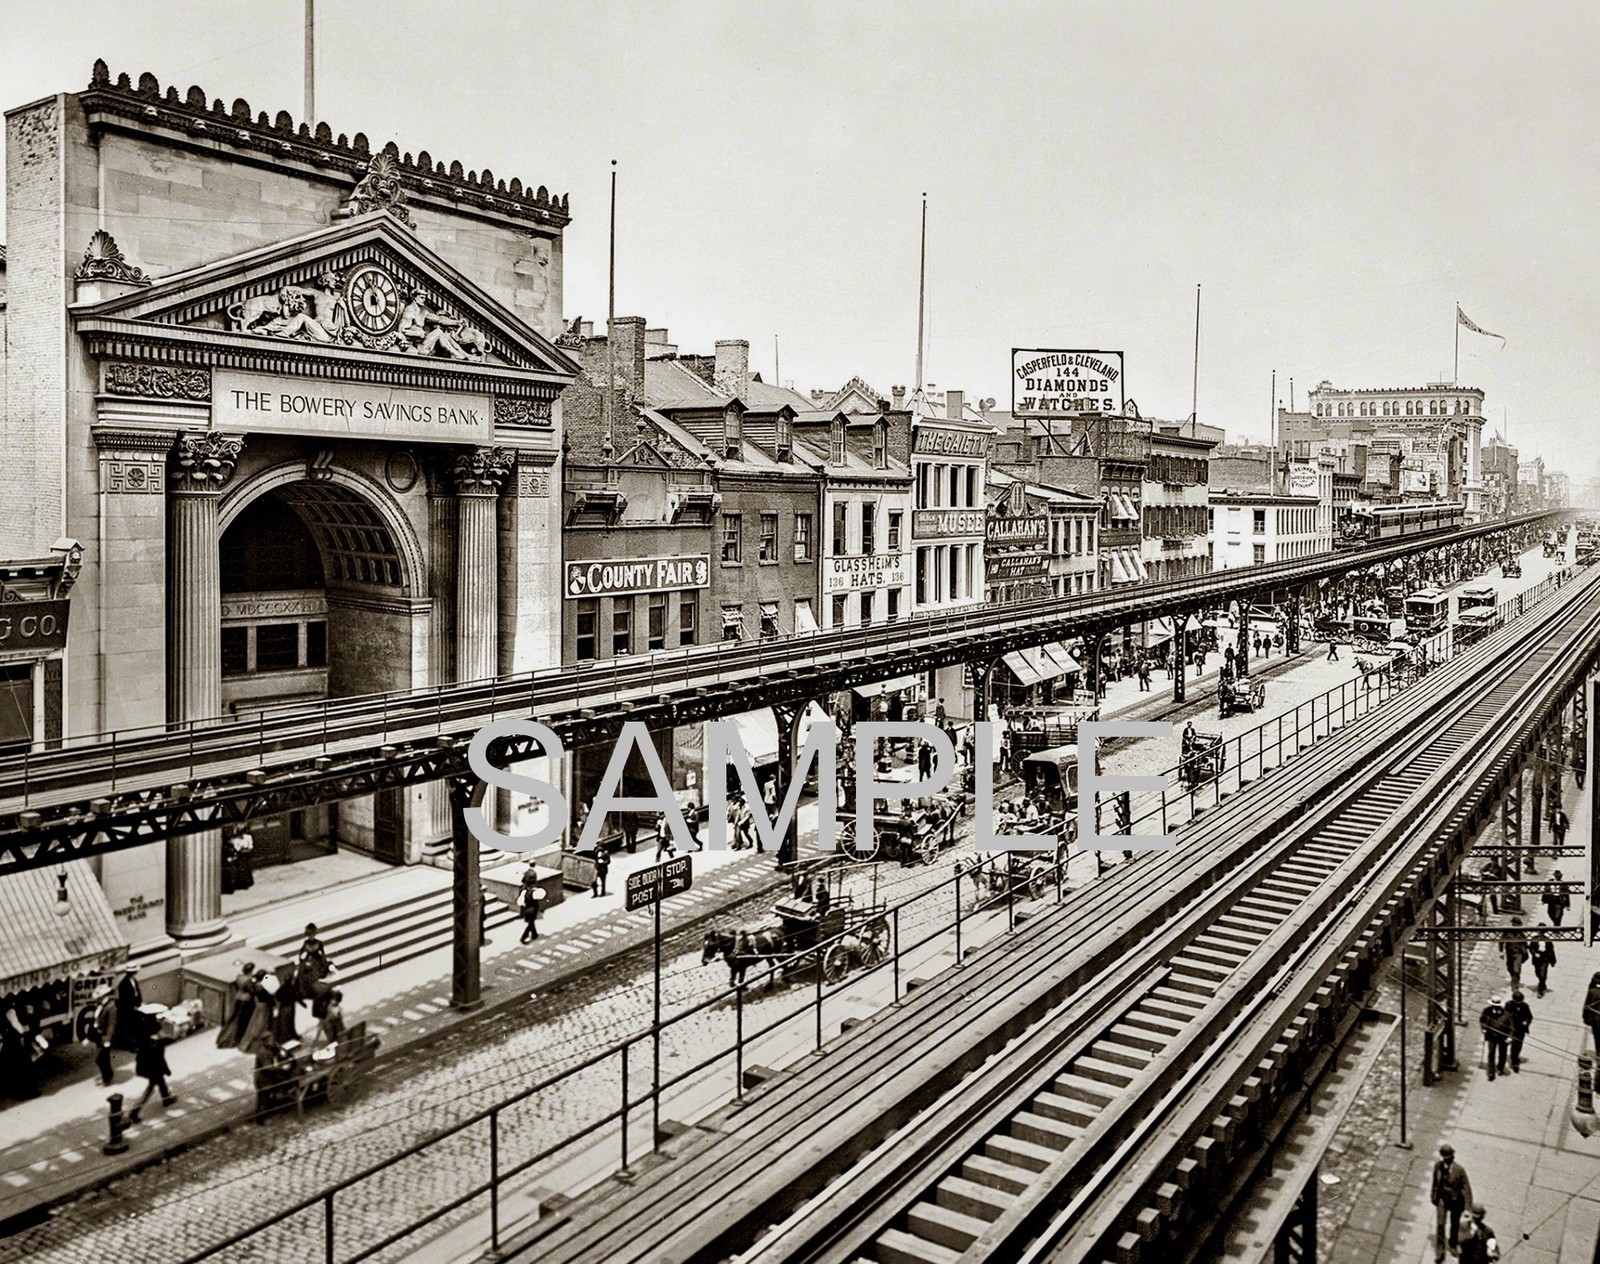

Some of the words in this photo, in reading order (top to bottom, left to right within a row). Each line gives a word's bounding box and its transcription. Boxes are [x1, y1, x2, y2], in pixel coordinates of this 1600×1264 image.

[1016, 354, 1066, 379] CASPERFELD
[1075, 354, 1119, 383] CLEVELAND.
[1056, 367, 1079, 377] 144
[1025, 378, 1109, 392] DIAMONDS
[231, 390, 272, 412] THE
[280, 394, 357, 417] BOWERY
[363, 401, 432, 422] SAVINGS
[1022, 397, 1116, 411] WATCHES.
[918, 431, 944, 452] THE
[943, 433, 987, 455] GAIETY
[937, 513, 983, 533] MUSEE
[834, 556, 900, 573] GLASSHEIM'S
[586, 563, 654, 593] COUNTY
[656, 560, 693, 588] FAIR
[20, 614, 61, 639] CO.
[666, 860, 688, 877] STOP.
[632, 887, 654, 905] POST
